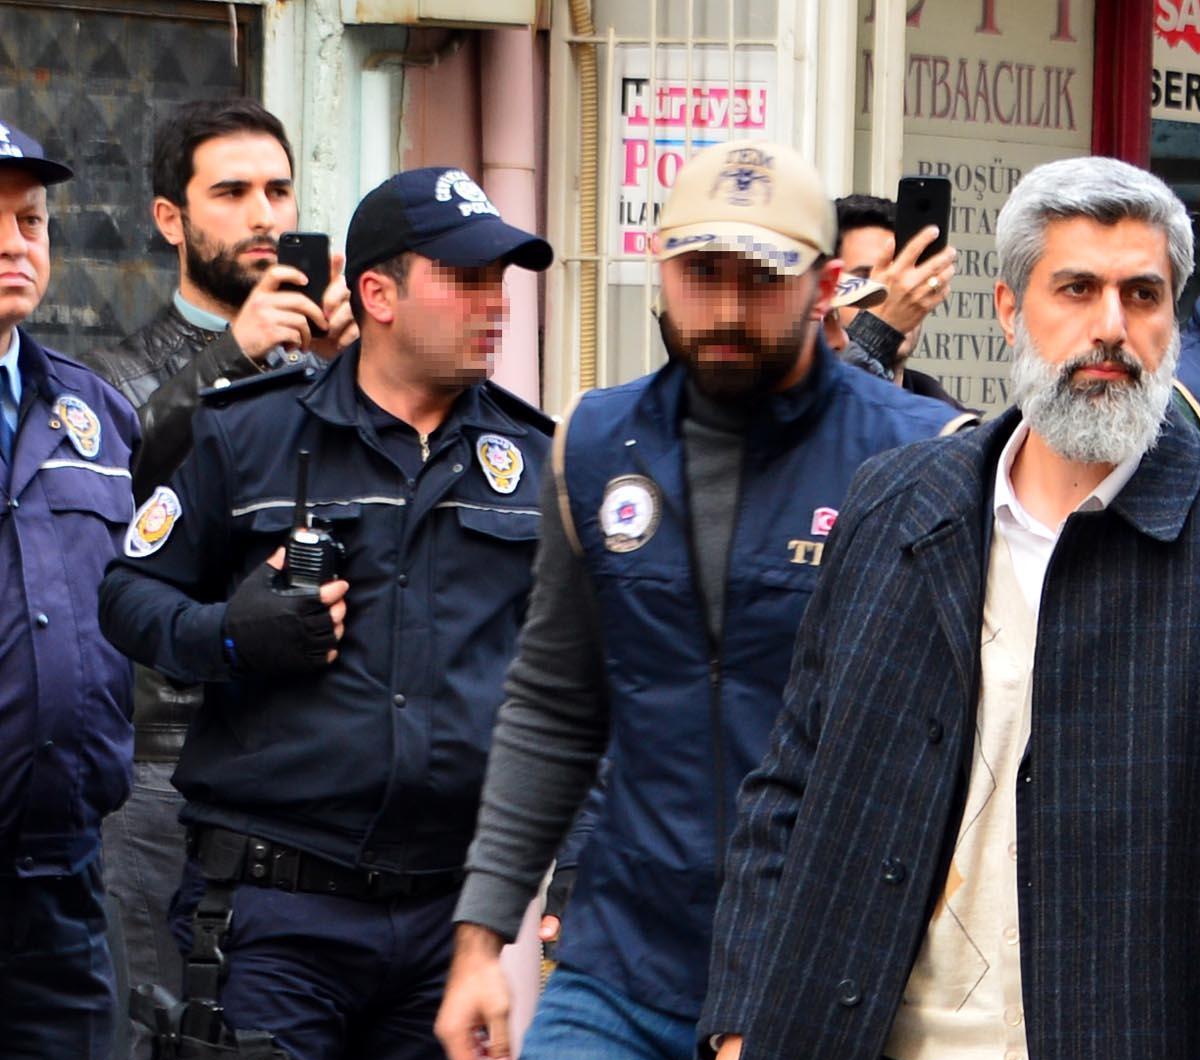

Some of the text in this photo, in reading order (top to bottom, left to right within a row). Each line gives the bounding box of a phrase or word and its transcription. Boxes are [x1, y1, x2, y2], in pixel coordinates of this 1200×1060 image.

[861, 48, 1077, 131] TBAACILIK
[950, 197, 1000, 235] İTA
[911, 326, 1012, 362] ARTVİZ
